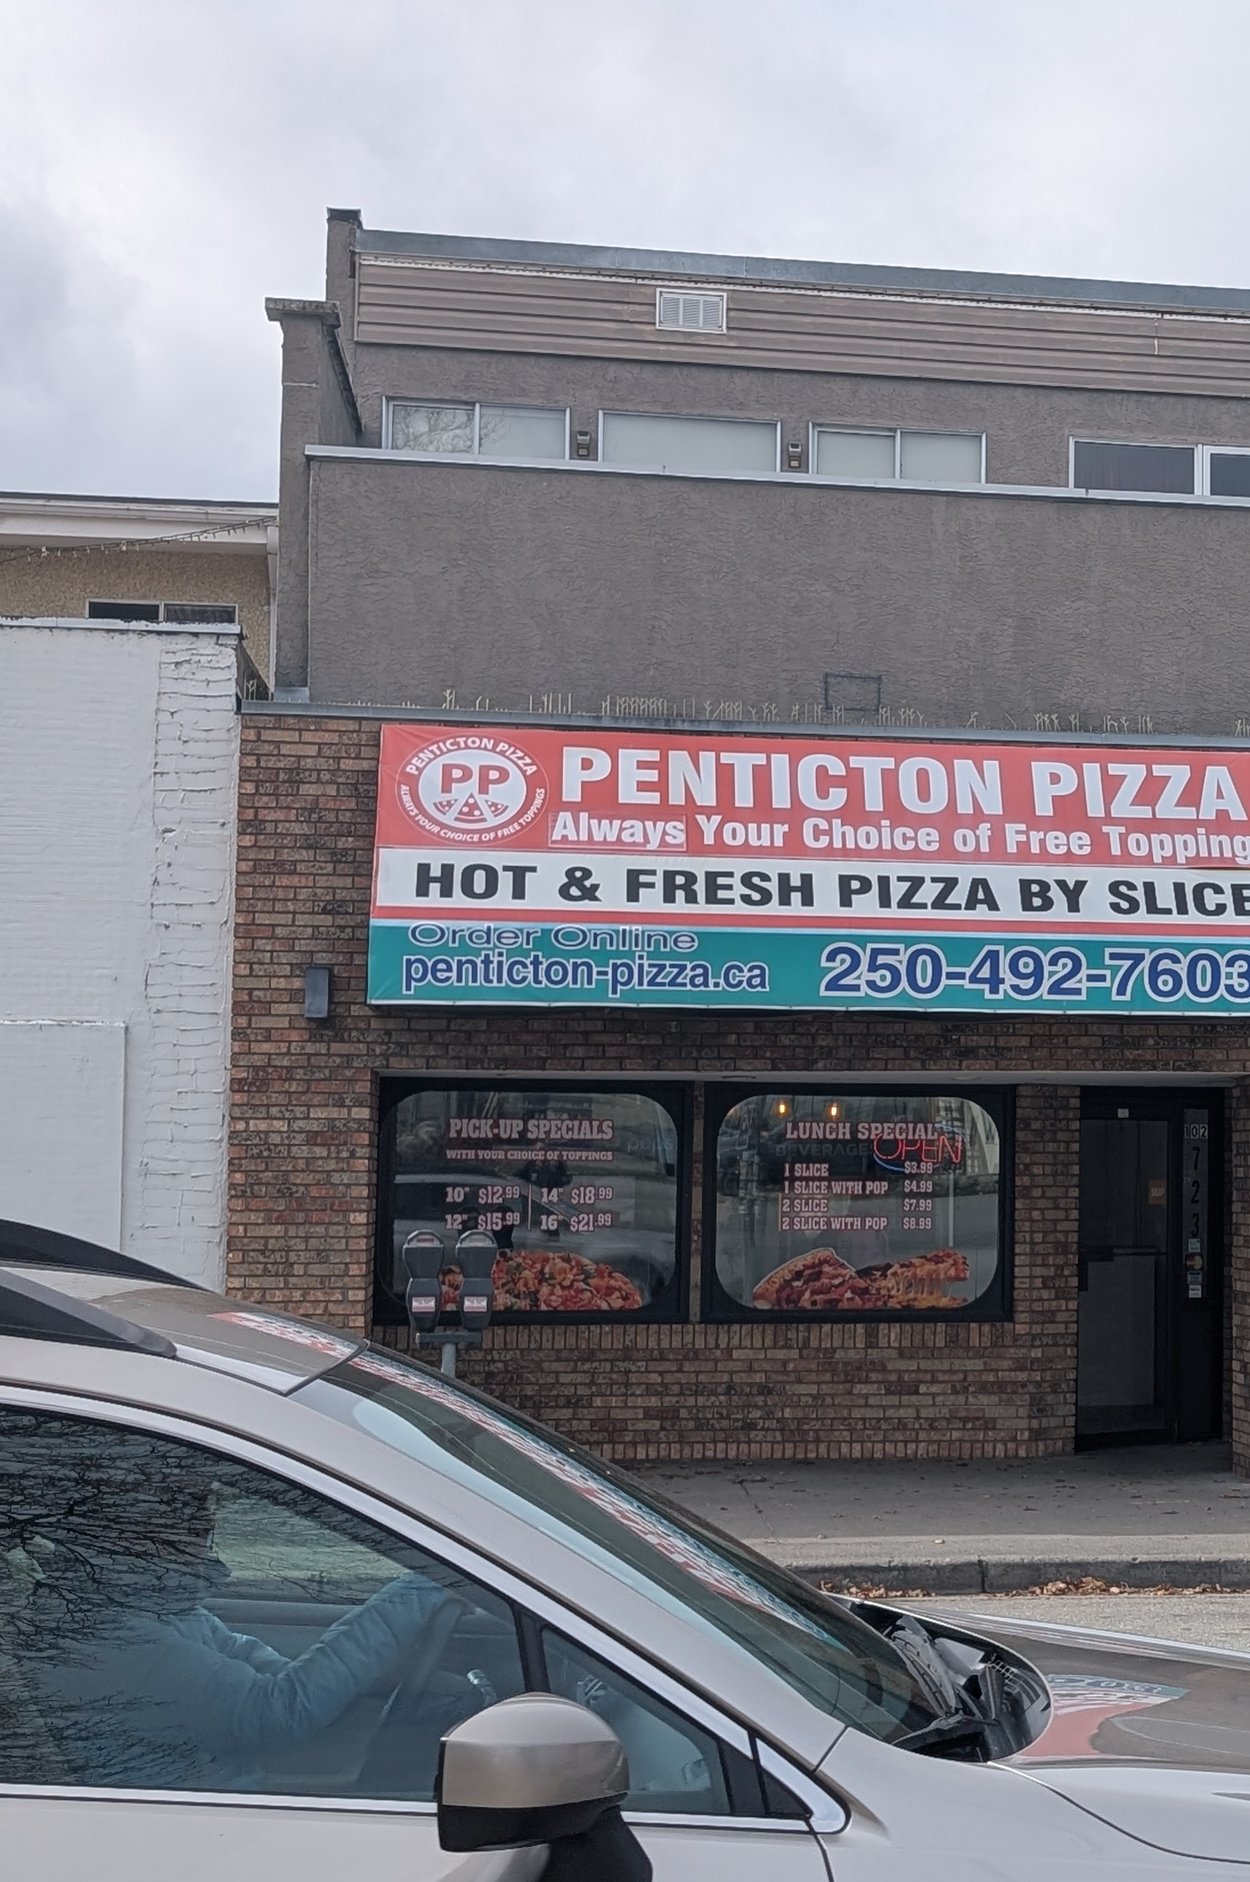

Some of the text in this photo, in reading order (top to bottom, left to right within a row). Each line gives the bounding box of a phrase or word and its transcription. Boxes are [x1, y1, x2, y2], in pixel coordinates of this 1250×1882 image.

[405, 736, 538, 776] PENTICTON PIZZA
[440, 762, 511, 797] PP
[562, 746, 1248, 822] PENTICTON PIZZA
[414, 812, 441, 834] YOUR
[439, 828, 480, 843] CHOICE
[481, 832, 496, 842] OF
[497, 825, 522, 839] FREE
[518, 786, 546, 827] TOPPINGS
[551, 811, 686, 851] Always
[695, 813, 789, 849] Your
[802, 816, 940, 852] Choice
[953, 822, 992, 854] of
[1005, 823, 1092, 856] Free
[414, 862, 538, 900] HOT
[557, 866, 602, 903] &
[625, 868, 815, 908] FRESH
[837, 873, 1001, 912] PIZZA
[1018, 878, 1089, 914] BY
[408, 921, 699, 952] Order Online
[401, 950, 769, 998] penticton-pizza.ca
[448, 1117, 614, 1141] PICK-UP SPECIALS
[785, 1121, 851, 1140] LUNCH
[1184, 1123, 1209, 1140] 102
[446, 1149, 614, 1162] WITH YOUR CHOICE OF TOPPINGS
[873, 1131, 964, 1164] OPEN
[783, 1160, 934, 1178] 1 SLICE $3.99
[477, 1185, 521, 1205] $12.99
[570, 1186, 614, 1205] $18.99
[783, 1179, 934, 1196] 1 SLICE WITH POP $4.99
[782, 1198, 933, 1213] 2 SLICE $7.99
[477, 1211, 521, 1232] $15.99
[569, 1213, 612, 1233] $21.99
[781, 1217, 790, 1231] 2
[793, 1217, 828, 1231] SLICE
[830, 1217, 862, 1231] WITH
[865, 1217, 888, 1231] POP
